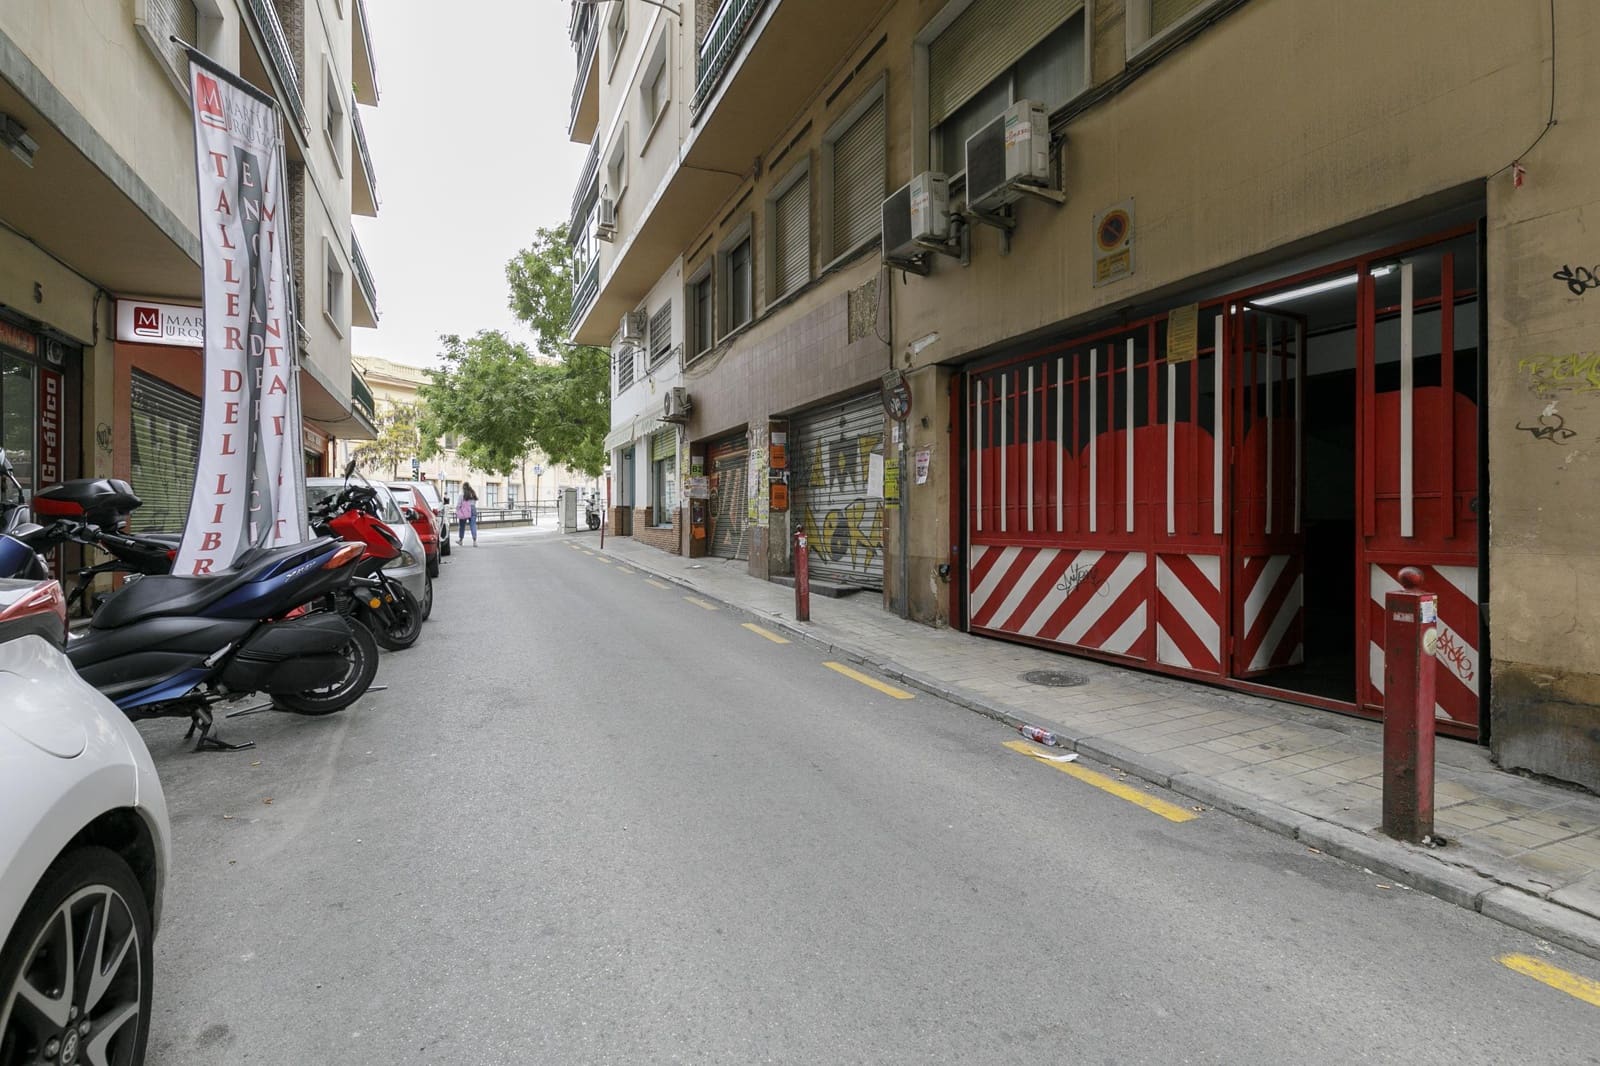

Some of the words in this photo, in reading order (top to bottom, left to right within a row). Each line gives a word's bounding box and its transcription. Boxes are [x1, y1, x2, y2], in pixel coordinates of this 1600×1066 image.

[209, 151, 244, 351] TALLER
[138, 311, 158, 326] M
[42, 377, 57, 482] Gráfico
[218, 368, 243, 456] DEL
